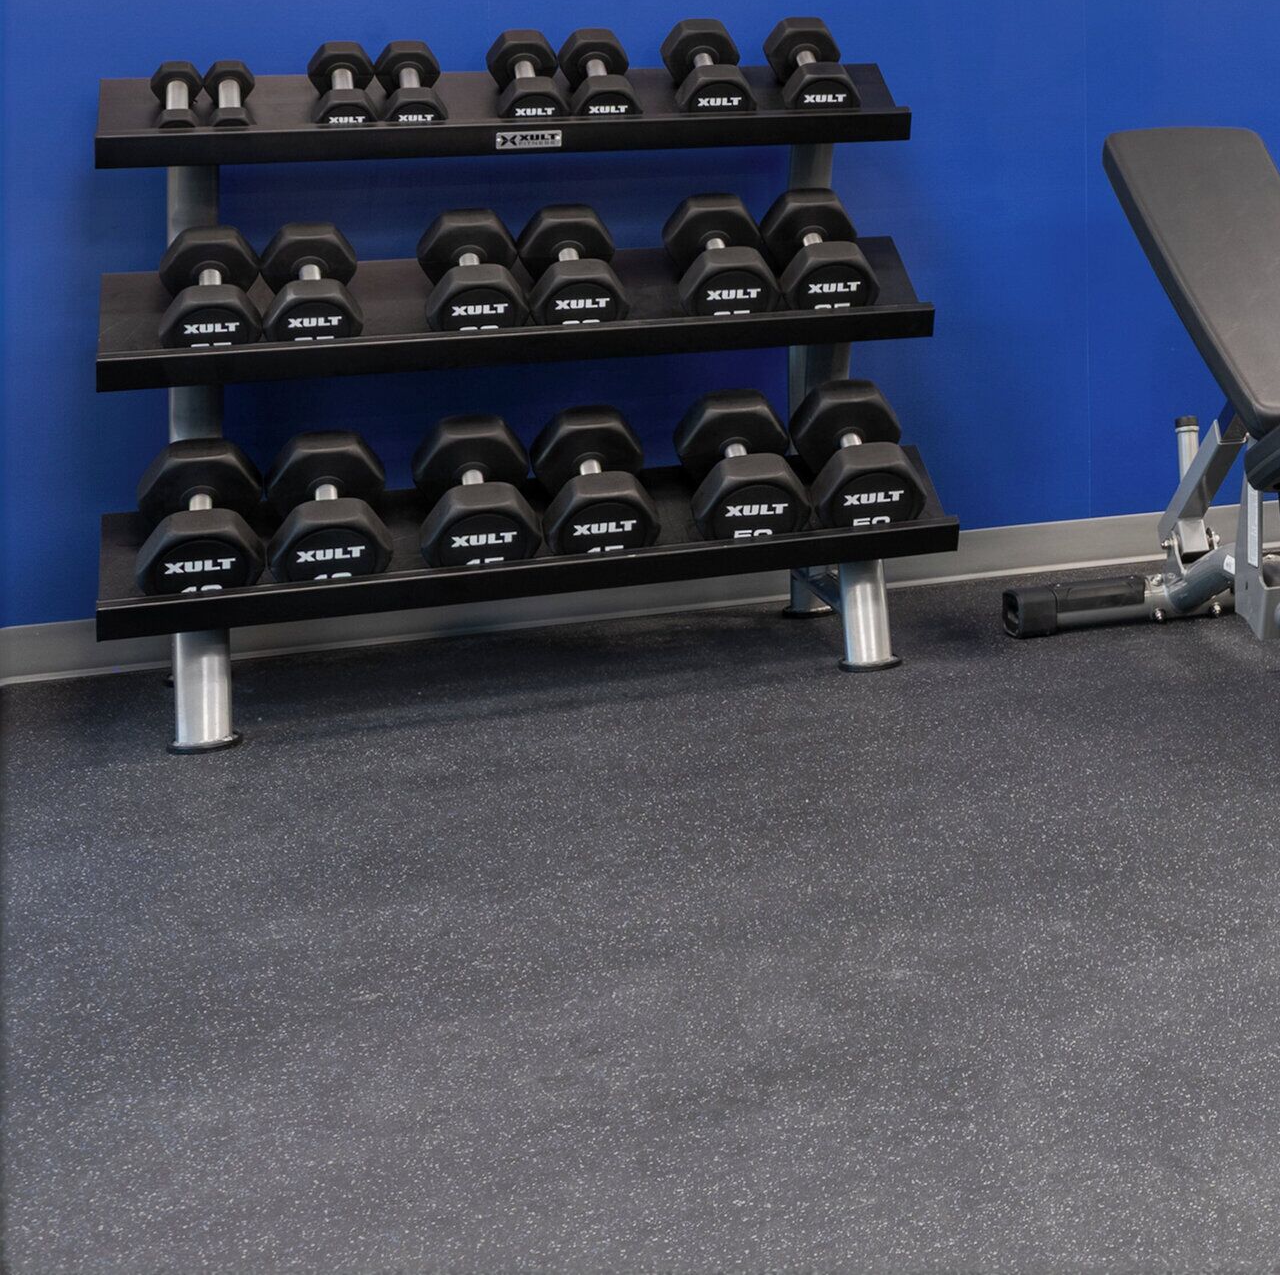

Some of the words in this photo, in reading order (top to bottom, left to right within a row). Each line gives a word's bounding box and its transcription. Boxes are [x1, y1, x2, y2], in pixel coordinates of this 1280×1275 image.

[697, 97, 742, 107] XULT
[803, 93, 847, 103] XULT
[514, 107, 556, 116] XULT
[588, 105, 628, 114] XULT
[329, 115, 365, 124] XULT
[399, 113, 434, 123] XULT
[706, 288, 762, 301] XULT
[807, 281, 861, 294] XULT
[452, 303, 509, 317] XULT
[555, 297, 611, 311] XULT
[183, 321, 240, 335] XULT
[287, 315, 343, 329] XULT
[843, 489, 905, 507] XULT
[725, 503, 789, 518] XULT
[572, 519, 637, 536] XULT
[451, 531, 518, 548] XULT
[296, 545, 366, 563] XULT
[164, 557, 236, 575] XULT
